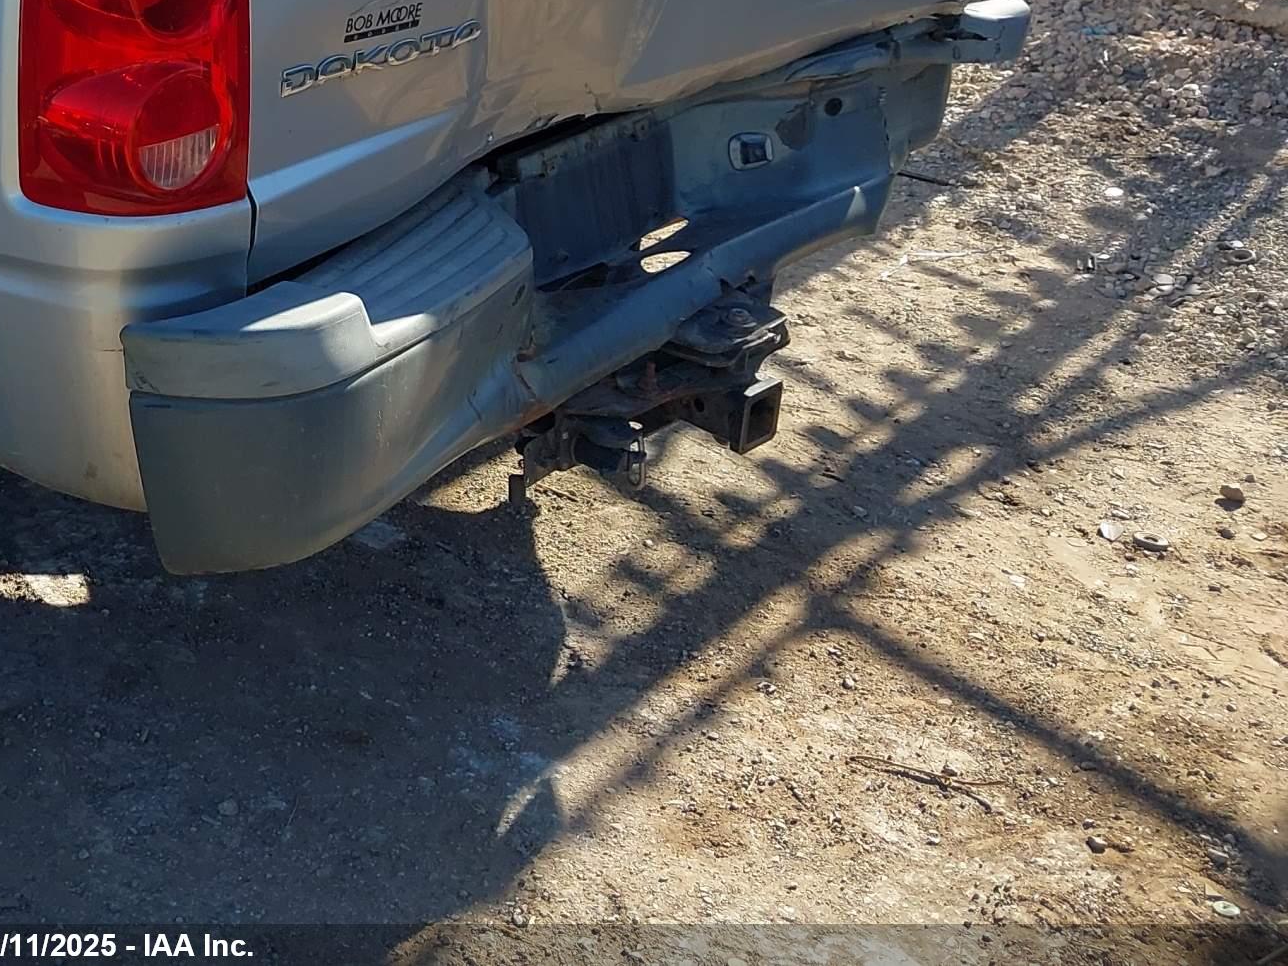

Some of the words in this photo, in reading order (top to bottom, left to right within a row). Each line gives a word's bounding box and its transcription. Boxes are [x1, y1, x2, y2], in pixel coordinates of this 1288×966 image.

[346, 13, 373, 33] BOB
[376, 2, 423, 27] MOORE
[280, 19, 481, 98] DAKOTA
